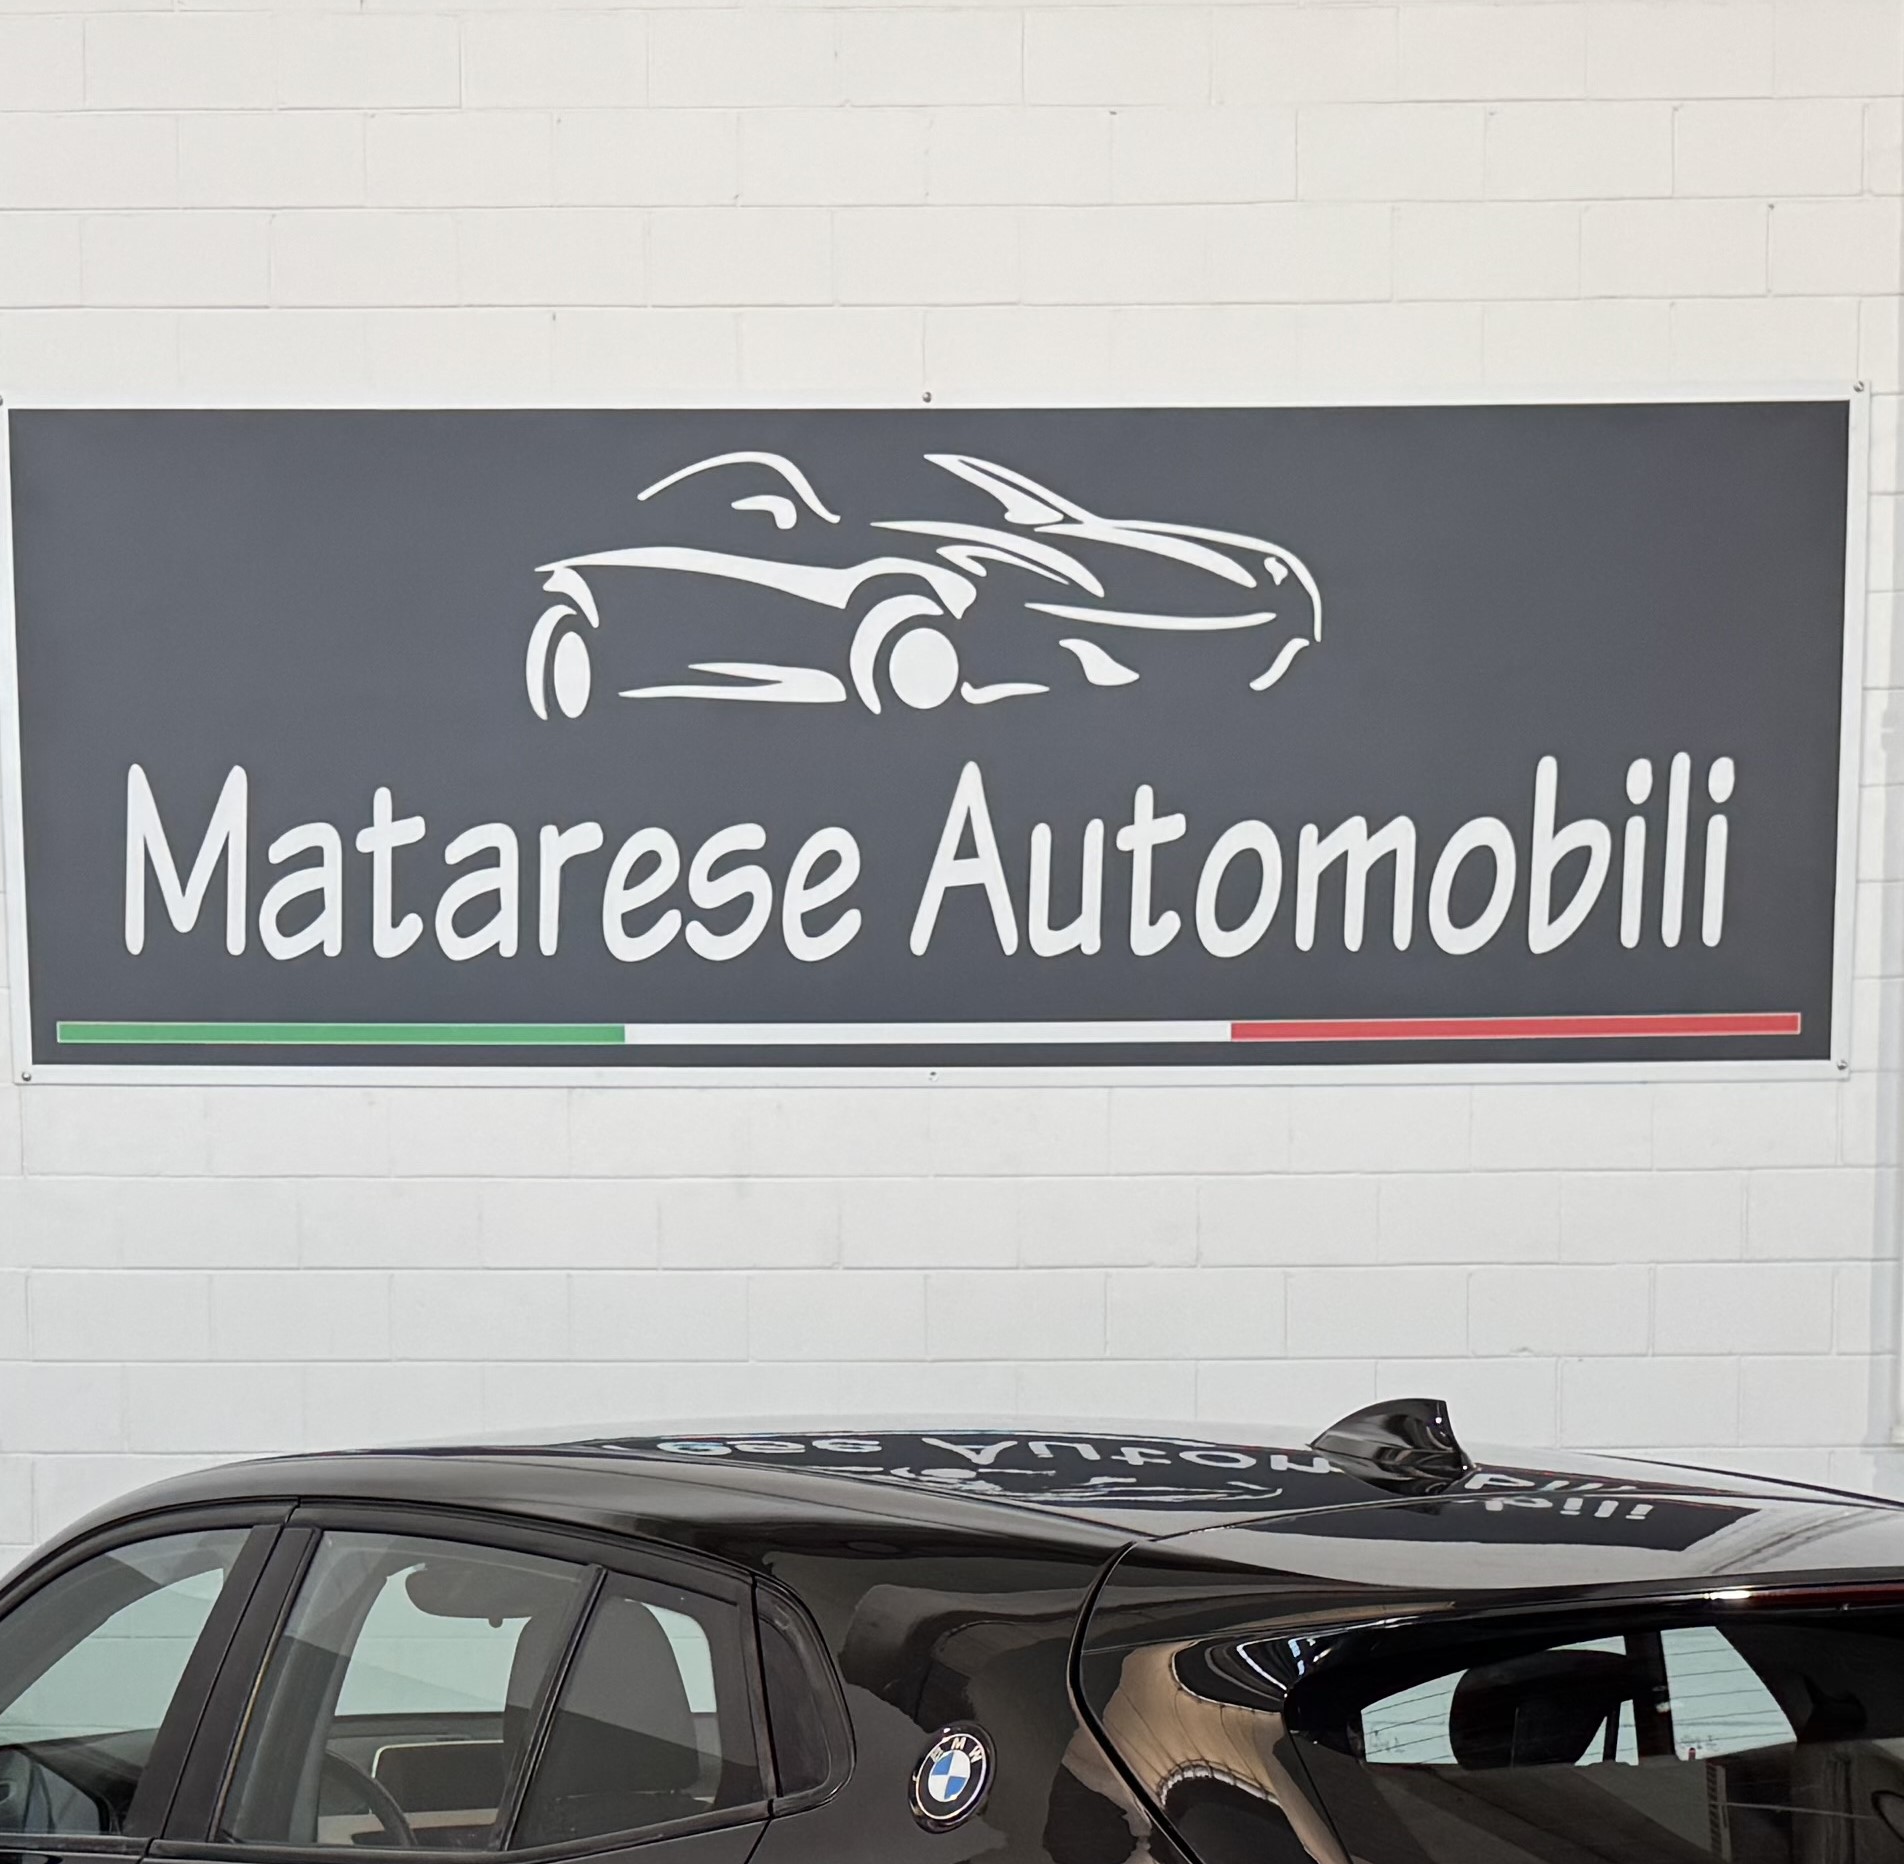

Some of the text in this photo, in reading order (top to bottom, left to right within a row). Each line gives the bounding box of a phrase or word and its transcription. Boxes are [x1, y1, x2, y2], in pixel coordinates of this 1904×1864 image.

[125, 751, 1735, 962] Matarese Automobili
[930, 1736, 983, 1763] BMW
